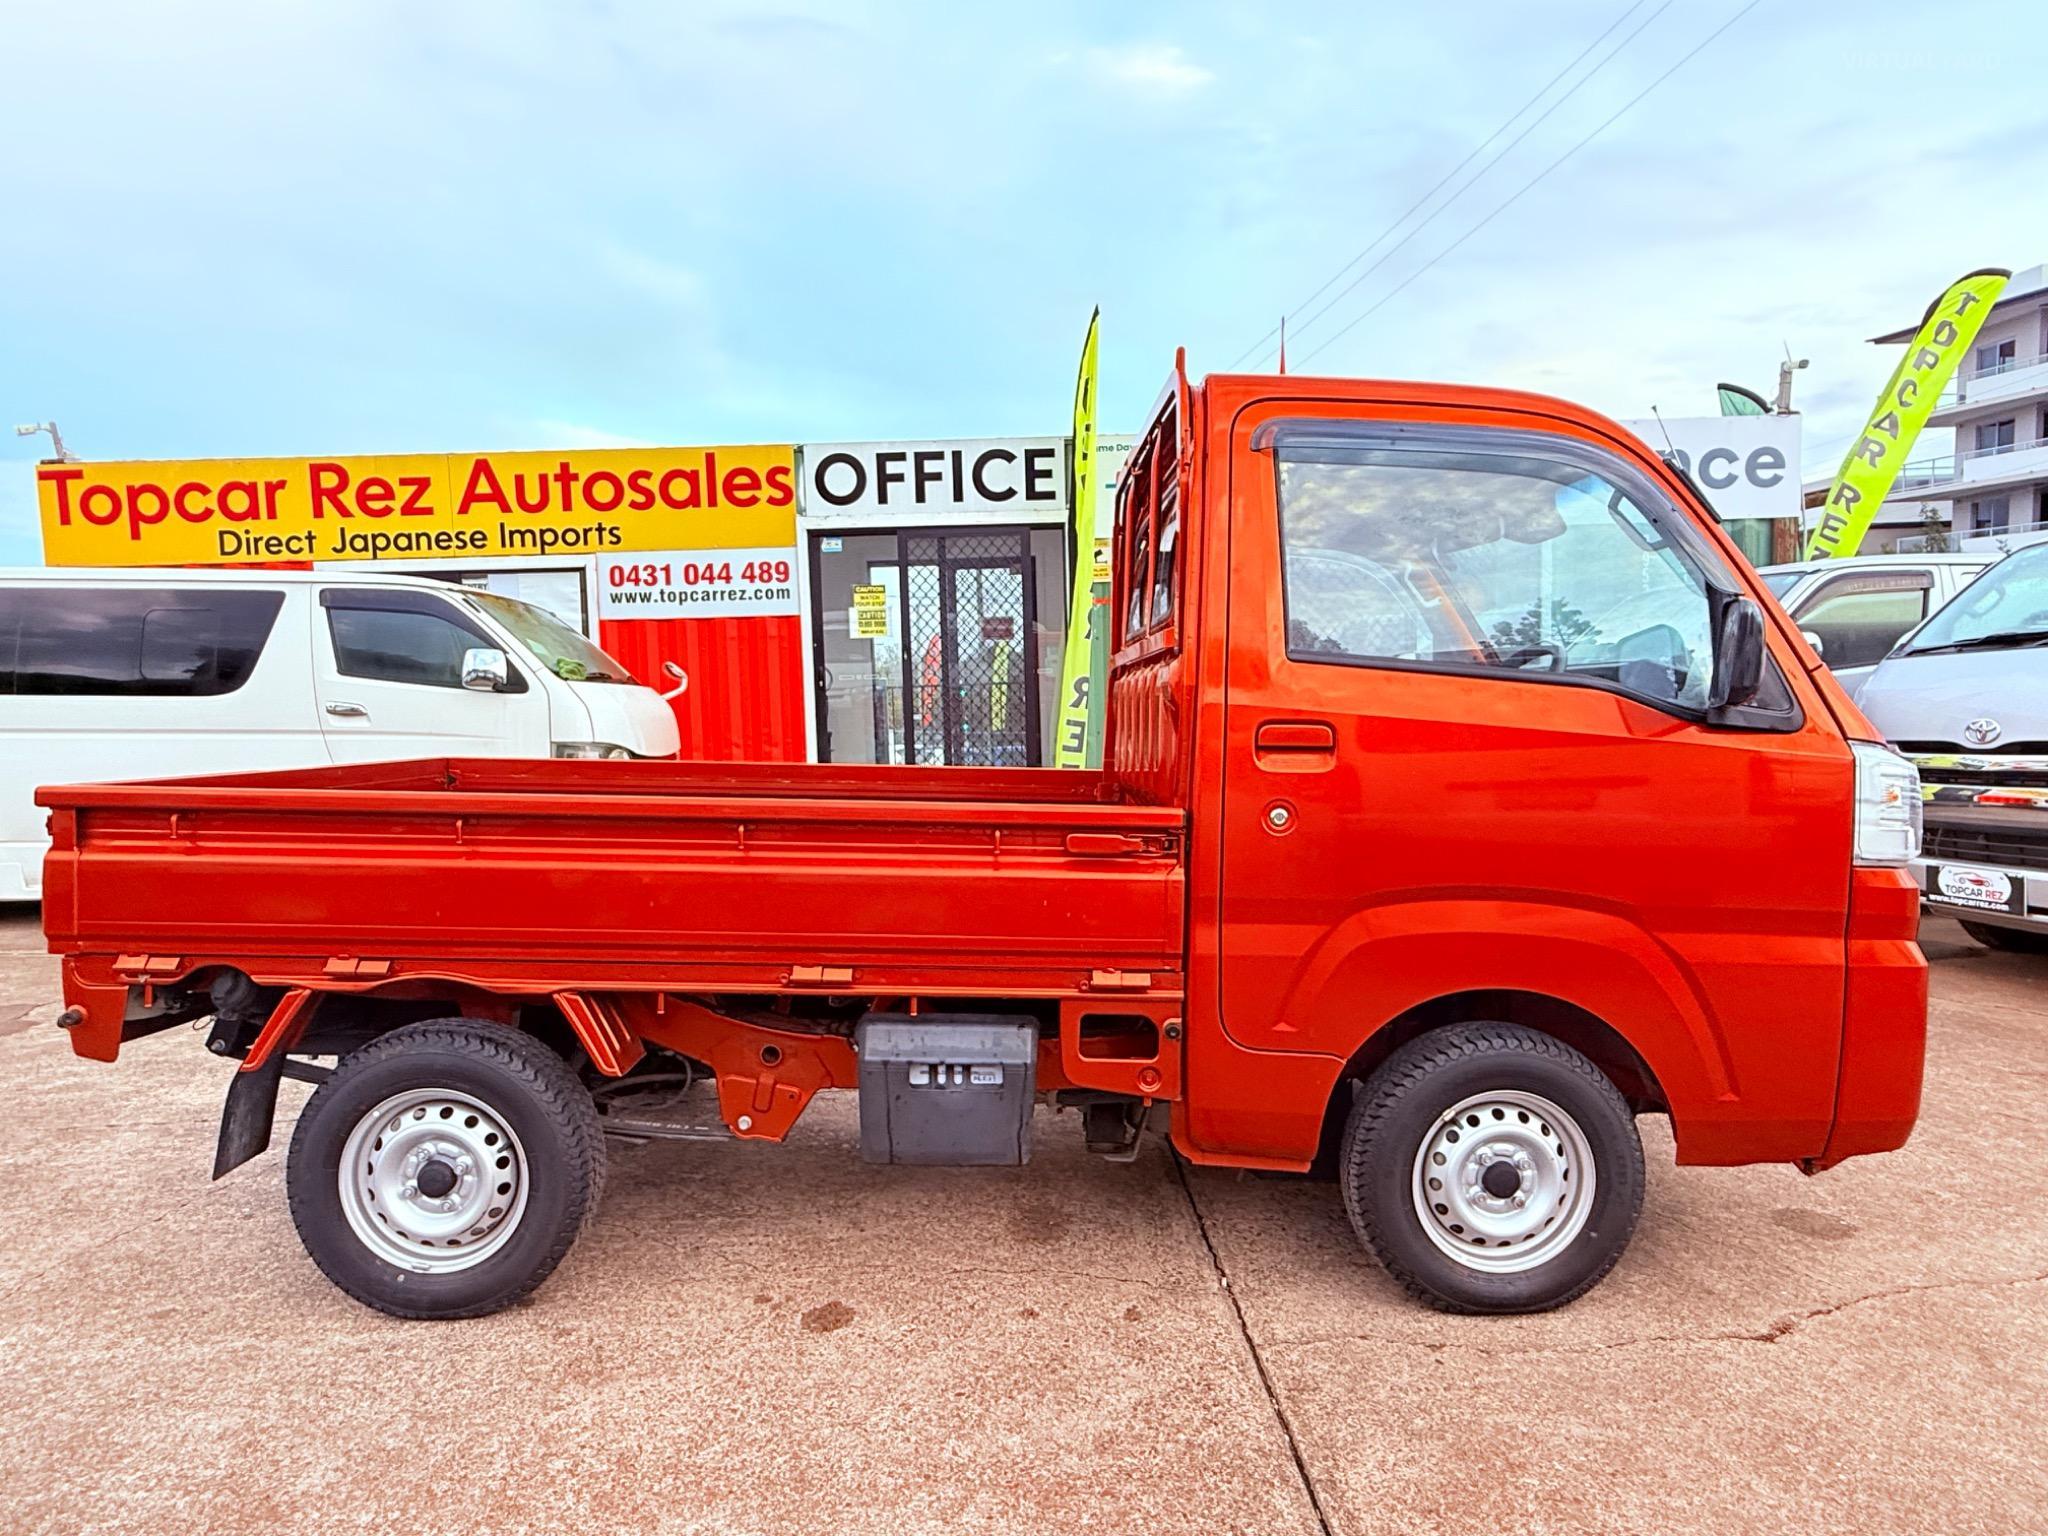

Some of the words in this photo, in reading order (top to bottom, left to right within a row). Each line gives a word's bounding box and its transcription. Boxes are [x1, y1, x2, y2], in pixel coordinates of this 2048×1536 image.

[1855, 291, 1980, 469] TOPCAR
[38, 469, 287, 540] Topcar
[308, 462, 434, 519] Rez
[457, 452, 793, 515] Autosales
[814, 448, 1056, 506] OFFICE
[219, 529, 316, 557] Direct
[331, 526, 488, 560] Japanese
[499, 522, 622, 555] Imports
[609, 564, 672, 587] 0431
[683, 562, 733, 585] 044
[741, 560, 790, 583] 489
[610, 588, 791, 605] www.topcarrez.com
[1945, 884, 1983, 898] TOPCAR
[1985, 890, 2004, 901] REZ
